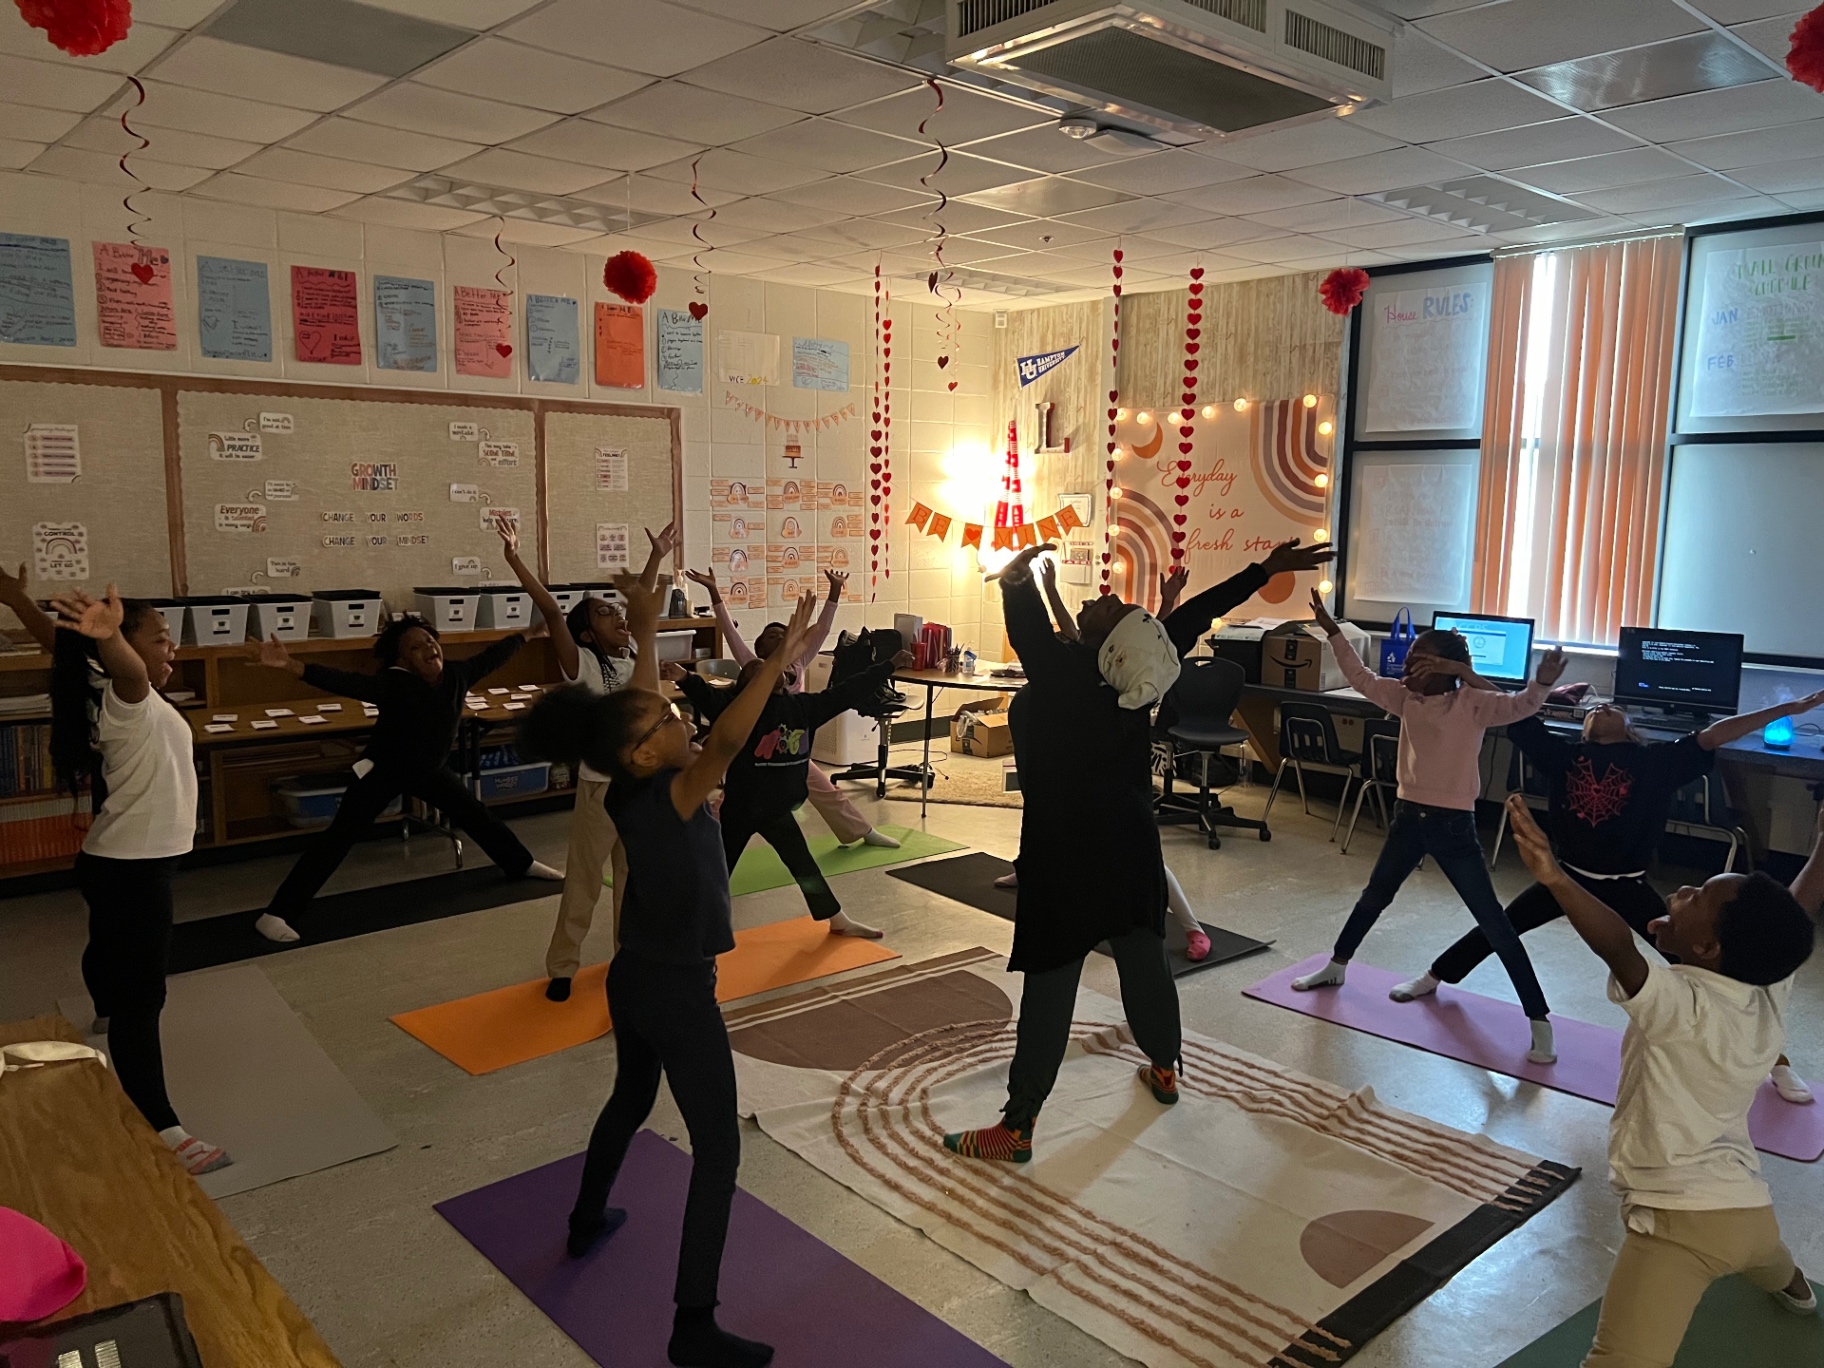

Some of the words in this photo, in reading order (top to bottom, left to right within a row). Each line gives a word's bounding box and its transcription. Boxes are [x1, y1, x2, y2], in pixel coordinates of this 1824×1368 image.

[662, 311, 669, 323] A
[1384, 304, 1418, 324] House
[1712, 308, 1739, 325] JAN
[1036, 352, 1065, 366] HAMPTON
[1707, 354, 1735, 371] FEB
[1034, 401, 1070, 454] L
[227, 444, 260, 452] PRACTICE
[351, 463, 397, 477] GROWTH
[352, 478, 399, 491] MINDSET
[220, 505, 259, 515] Everyone
[323, 512, 354, 522] CHANGE
[396, 512, 423, 521] WORDS
[1208, 503, 1226, 520] is
[1230, 510, 1244, 519] a
[911, 506, 950, 533] BE
[996, 509, 1078, 546] MINE
[324, 536, 355, 546] CHANGE
[398, 535, 429, 545] MINDSET
[1183, 528, 1234, 564] fresh
[1243, 535, 1296, 552] star
